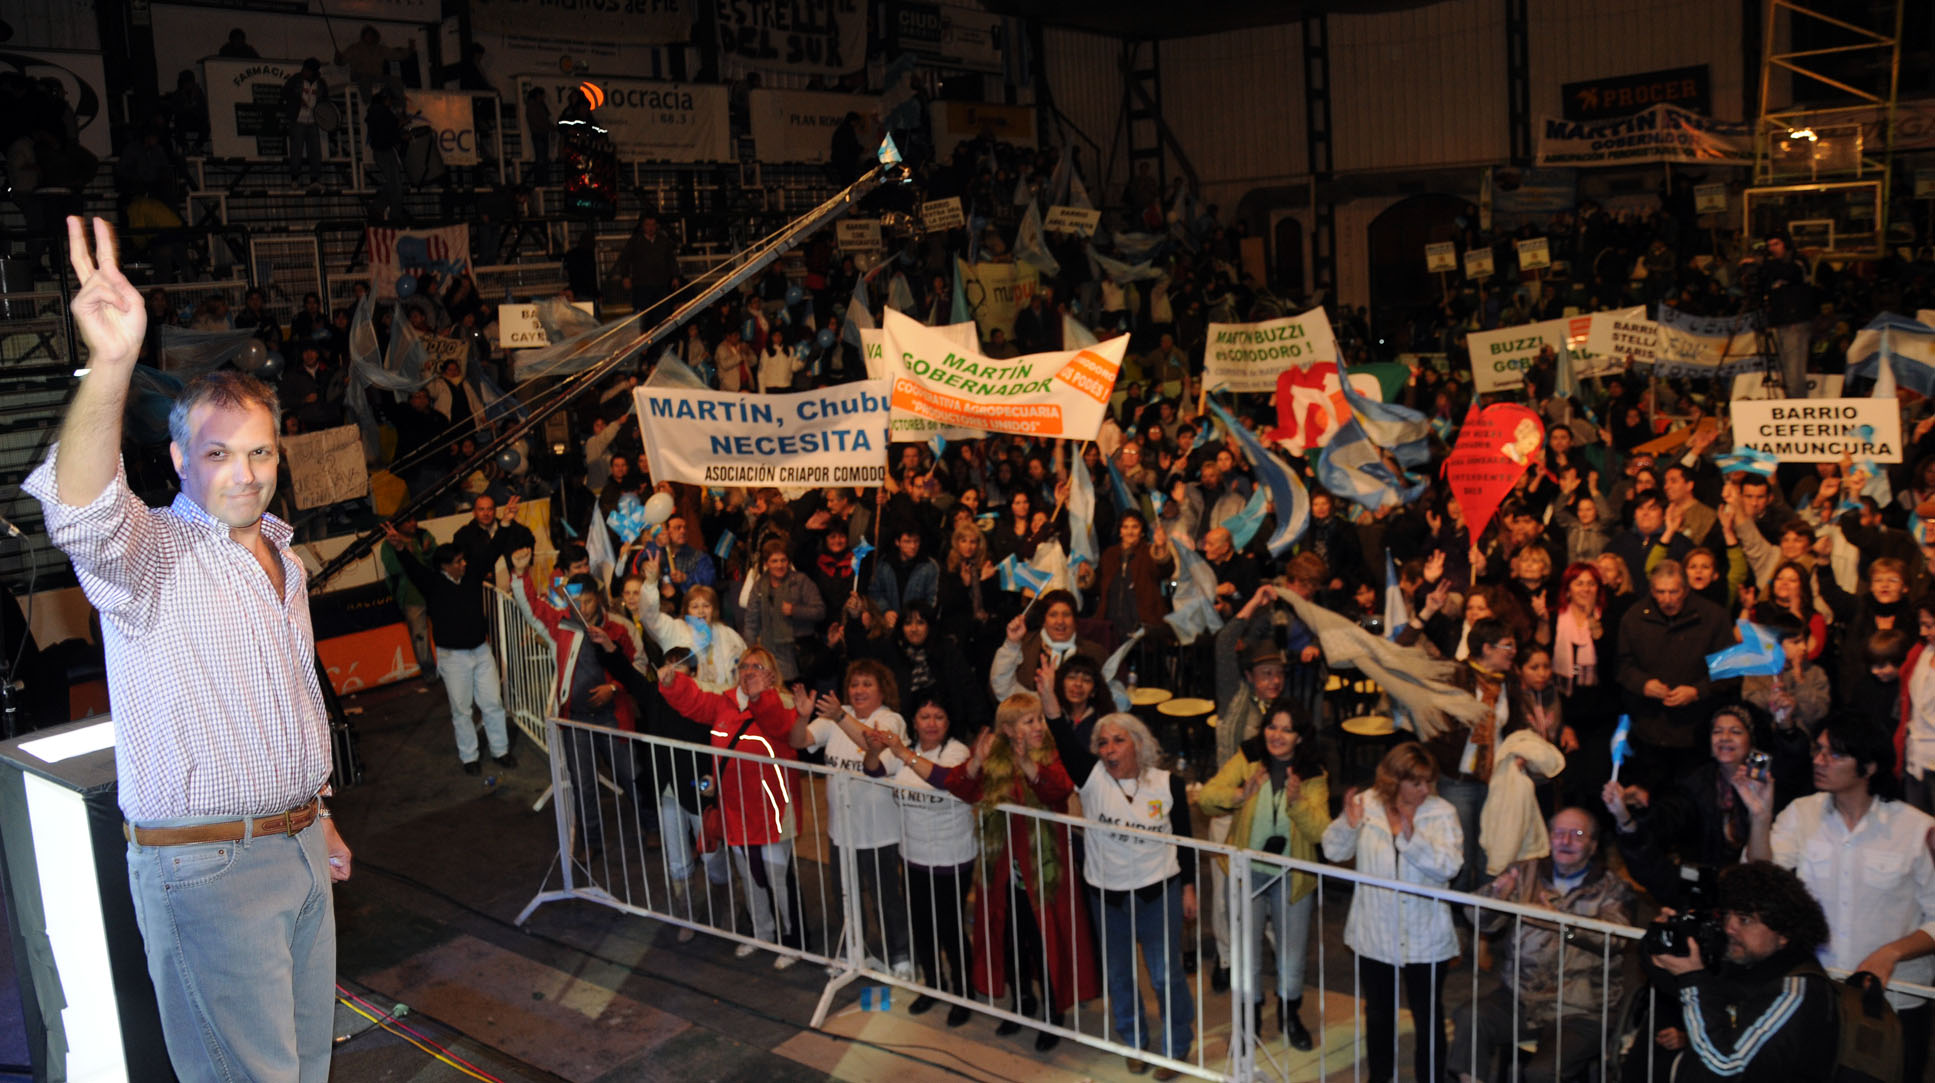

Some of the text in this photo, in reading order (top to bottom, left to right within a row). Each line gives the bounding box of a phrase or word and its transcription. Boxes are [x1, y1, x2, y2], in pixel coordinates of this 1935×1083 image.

[1601, 78, 1698, 109] PROCER
[1254, 324, 1305, 344] BUZZI
[1490, 336, 1543, 355] BUZZI
[901, 352, 1054, 397] GOBERNADOR
[942, 352, 1034, 380] MARTÍN
[648, 396, 785, 428] MARTÍN,
[963, 402, 1060, 420] AGROPECUARIA
[1771, 406, 1858, 420] BARRIO
[1759, 424, 1875, 438] CEFERIN
[709, 429, 873, 457] NECESITA
[1745, 442, 1893, 456] NAMUNCURA
[704, 463, 777, 482] ASOCIACIÓN
[779, 465, 831, 482] CRIAPOR
